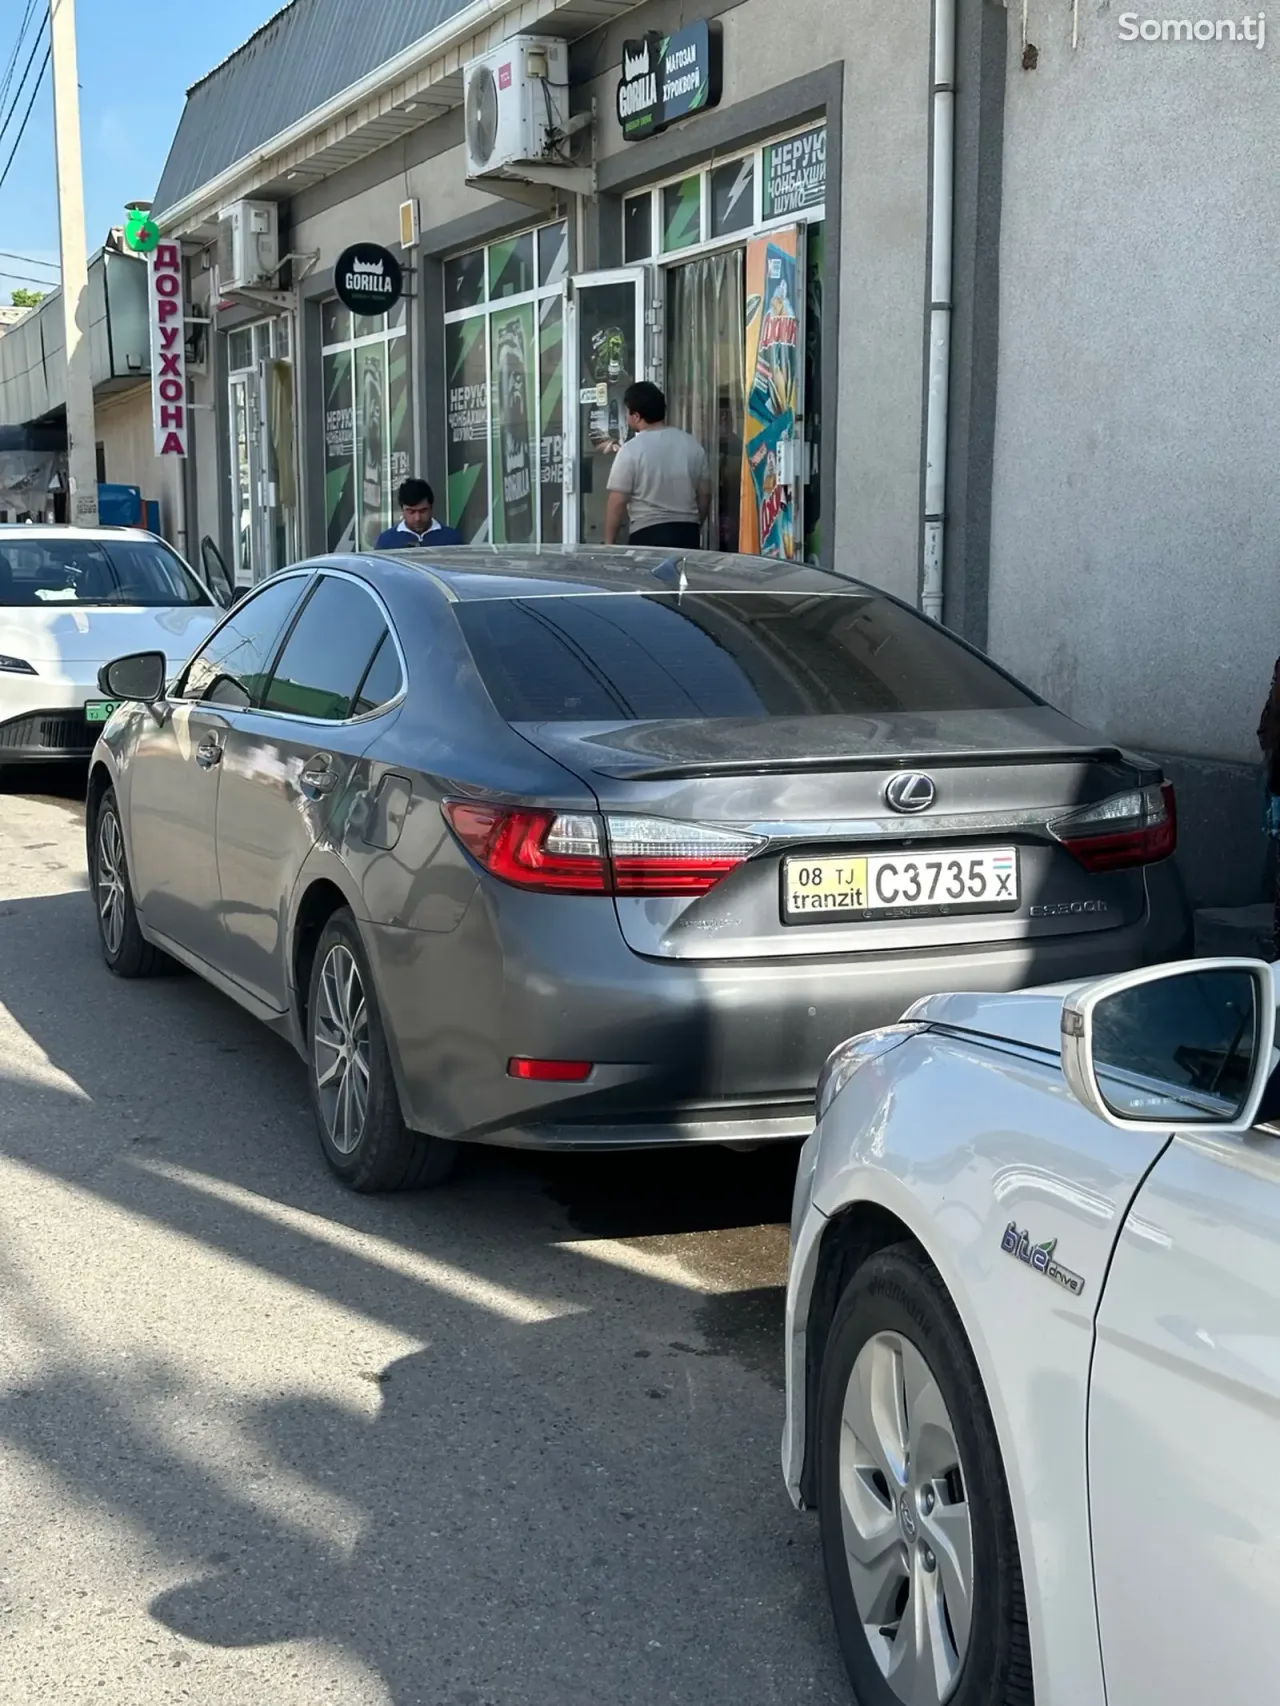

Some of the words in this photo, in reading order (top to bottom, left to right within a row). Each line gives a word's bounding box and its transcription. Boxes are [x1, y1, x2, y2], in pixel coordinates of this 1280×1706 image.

[619, 72, 657, 117] GORILLA
[345, 272, 392, 293] GORILLA
[153, 244, 185, 455] ДОРУХОНА
[799, 867, 823, 887] 08
[835, 868, 855, 885] TJ
[875, 859, 987, 904] C3735
[995, 873, 1012, 897] X
[792, 887, 863, 909] tranzit
[1048, 1265, 1079, 1291] drive
